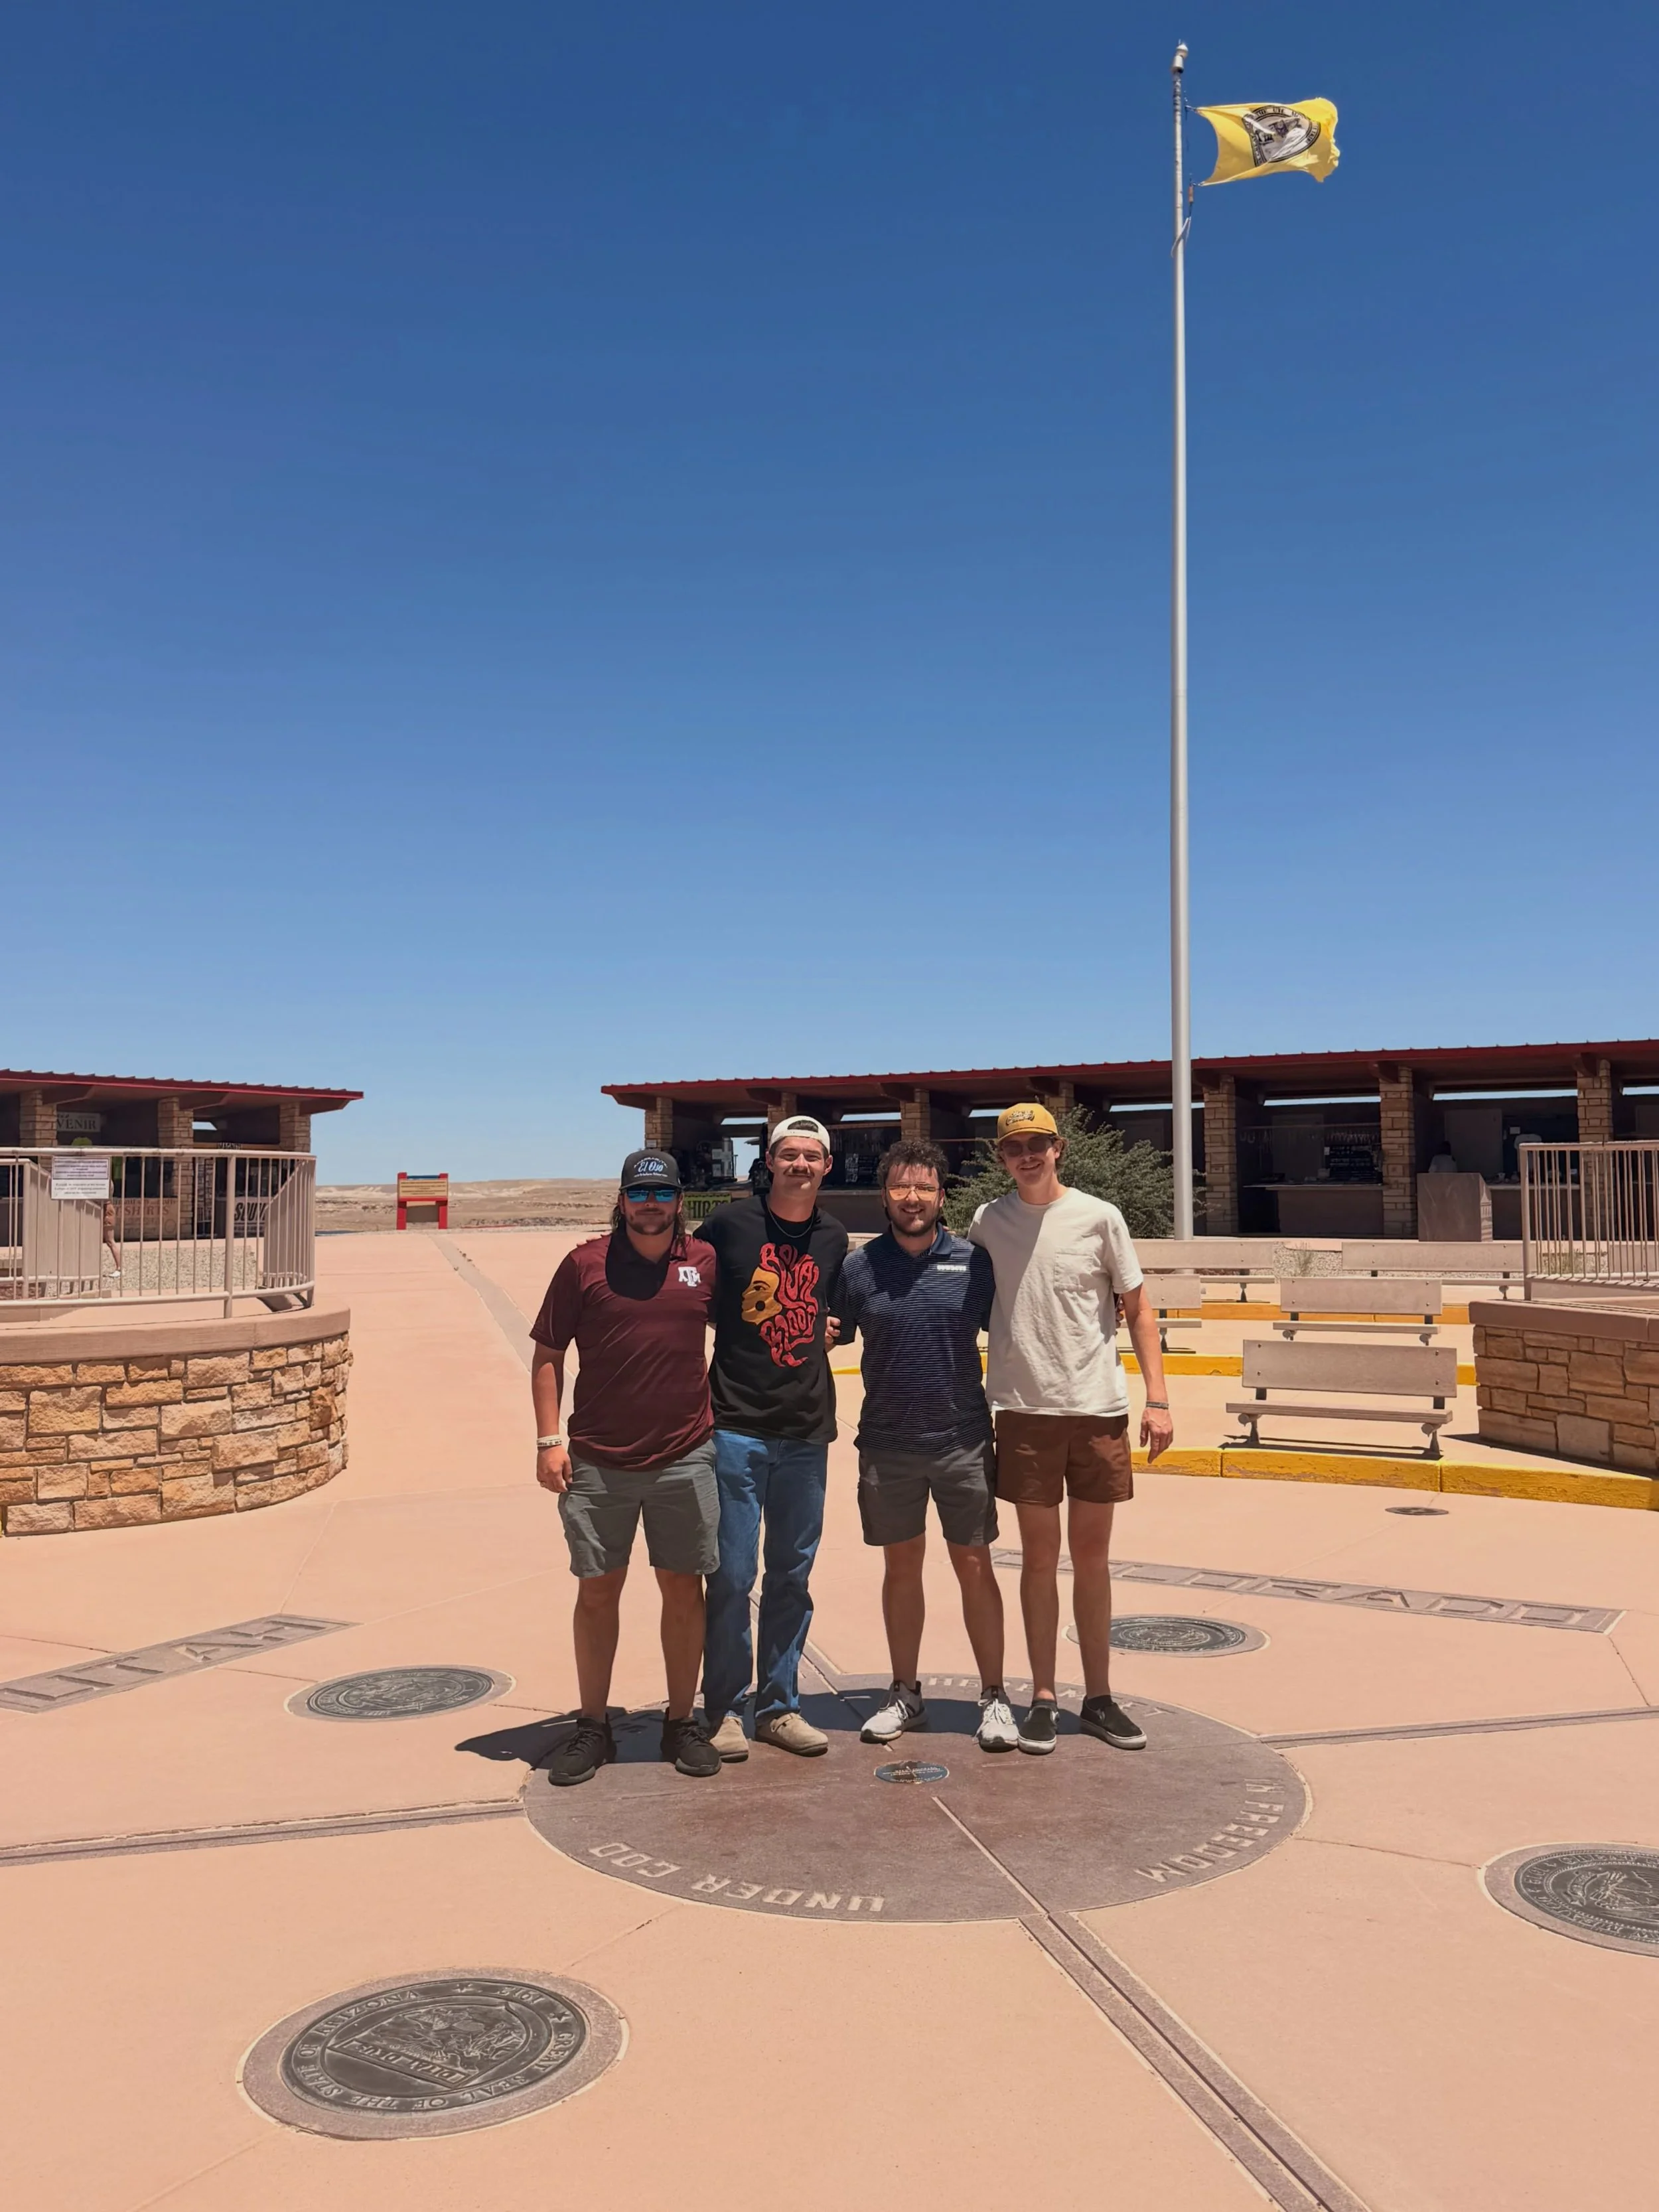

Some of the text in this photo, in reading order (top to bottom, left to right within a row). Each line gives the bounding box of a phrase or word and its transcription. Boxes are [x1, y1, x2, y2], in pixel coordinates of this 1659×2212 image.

[638, 1161, 664, 1172] El Oso
[759, 1242, 820, 1313] ROYAL
[759, 1305, 817, 1368] BLOOD
[2, 1619, 326, 1701] UTAH
[1133, 1778, 1286, 1883] IN FREEDOM
[691, 1874, 884, 1912] UNDER
[312, 1990, 421, 2037] ARIZONA
[534, 2032, 575, 2073] GREAT
[299, 2063, 343, 2097] STATE
[461, 2075, 528, 2104] SEAL
[350, 2095, 398, 2110] THE
[411, 2097, 447, 2110] OF
